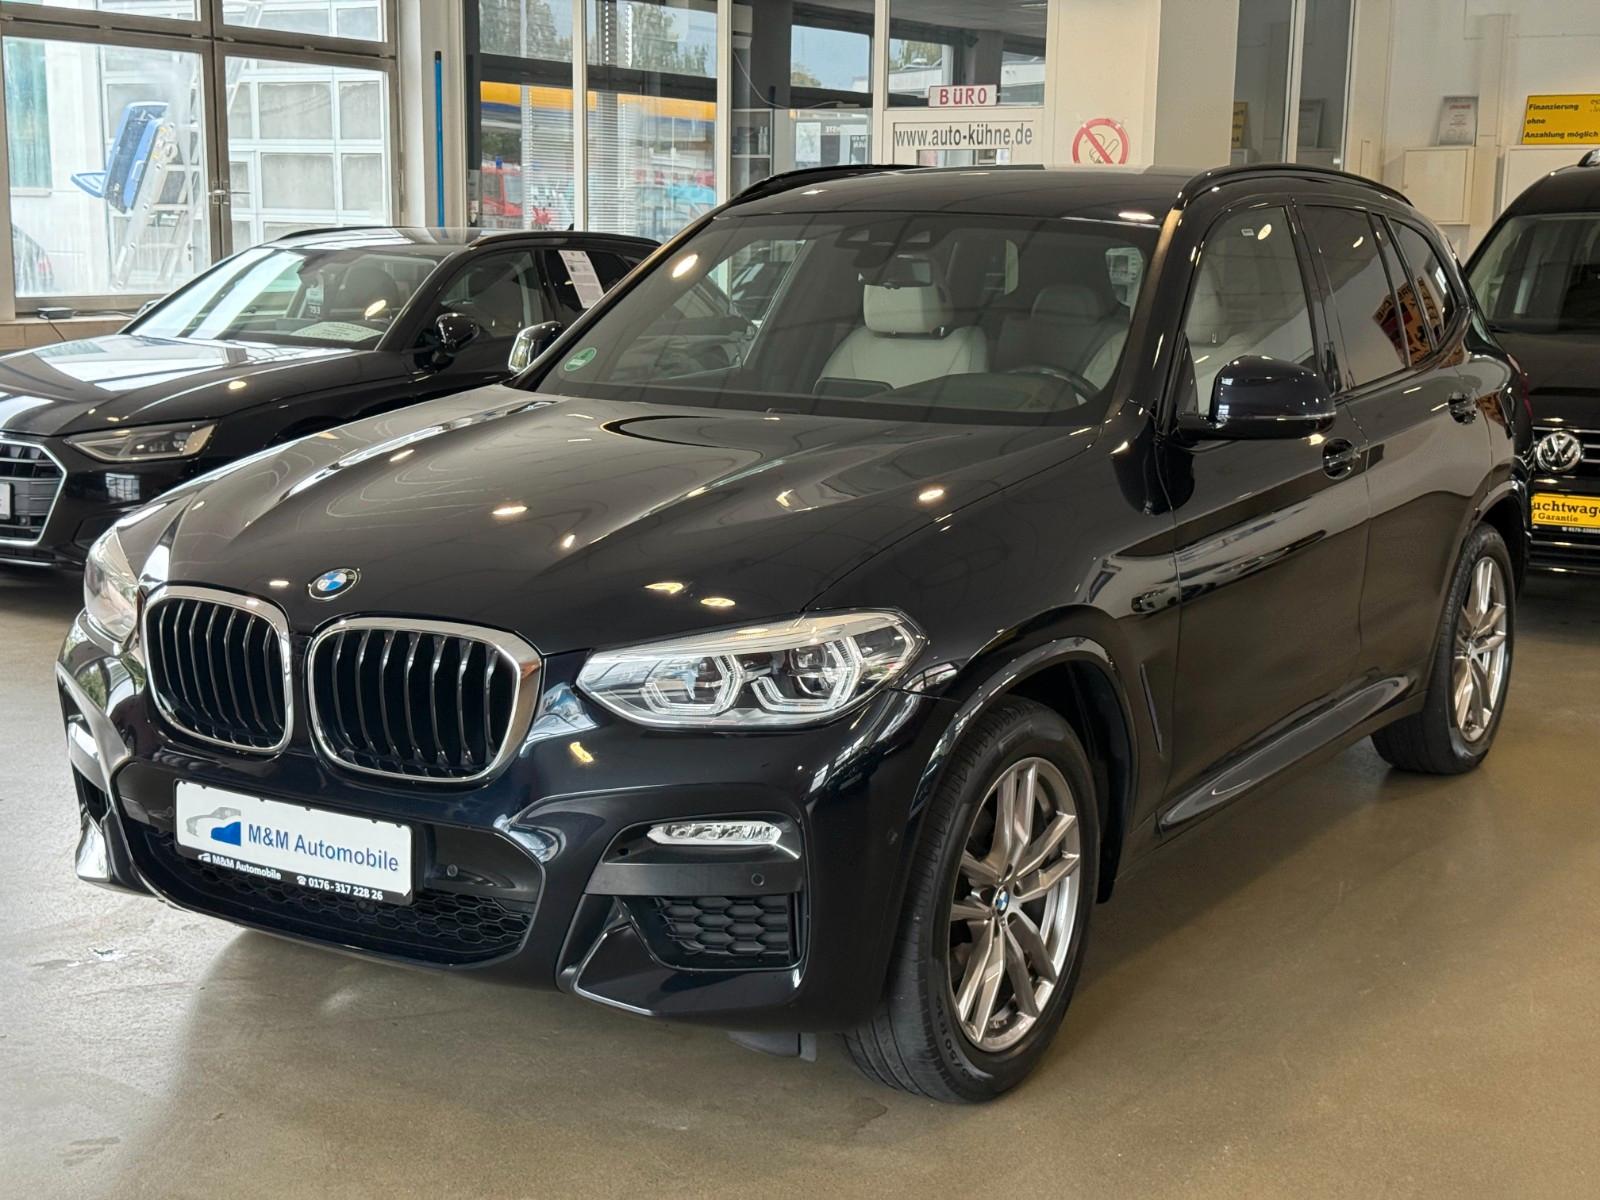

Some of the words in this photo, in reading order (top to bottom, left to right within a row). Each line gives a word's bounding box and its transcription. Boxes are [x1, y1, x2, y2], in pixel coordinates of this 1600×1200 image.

[1528, 103, 1579, 111] Finanzierung
[895, 123, 1033, 147] www.auto-kühne.de
[1524, 131, 1565, 139] Anzahlung
[1567, 130, 1599, 139] möglich
[1538, 512, 1578, 523] Garantie
[248, 823, 289, 850] M&M
[294, 834, 399, 872] Automobile
[212, 854, 235, 869] M&M
[236, 862, 282, 880] Automobile
[353, 887, 370, 899] 228
[371, 890, 384, 900] 26
